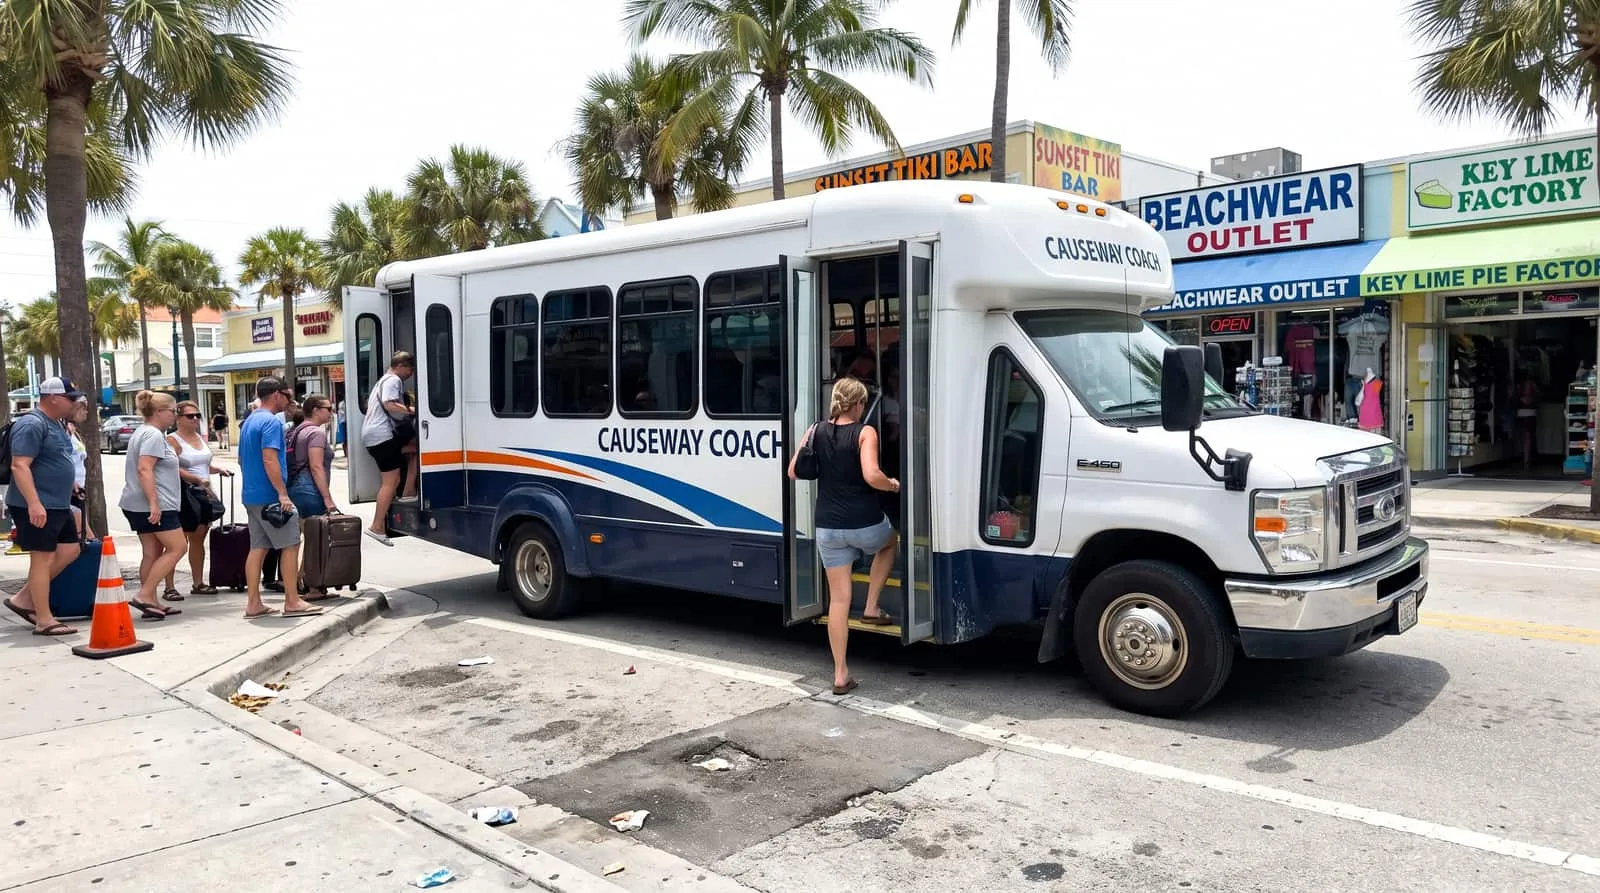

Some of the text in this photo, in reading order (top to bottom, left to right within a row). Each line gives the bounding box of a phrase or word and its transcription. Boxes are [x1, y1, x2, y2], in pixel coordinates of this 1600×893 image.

[815, 142, 993, 193] SUNSET TIKI BAR
[1036, 137, 1120, 180] SUNSET TIKI
[1461, 147, 1593, 186] KEY LIME
[1062, 171, 1099, 197] BAR
[1457, 176, 1587, 213] FACTORY
[1145, 173, 1353, 232] BEACHWEAR
[1187, 218, 1314, 253] OUTLET
[1045, 236, 1162, 272] CAUSEWAY COACH
[1150, 278, 1350, 311] ACHWEAR OUTLET
[1367, 274, 1407, 293] KEY
[1414, 269, 1465, 289] LIME
[1472, 265, 1508, 285] PIE
[1210, 318, 1251, 332] OPEN
[598, 427, 704, 456] CAUSEWAY
